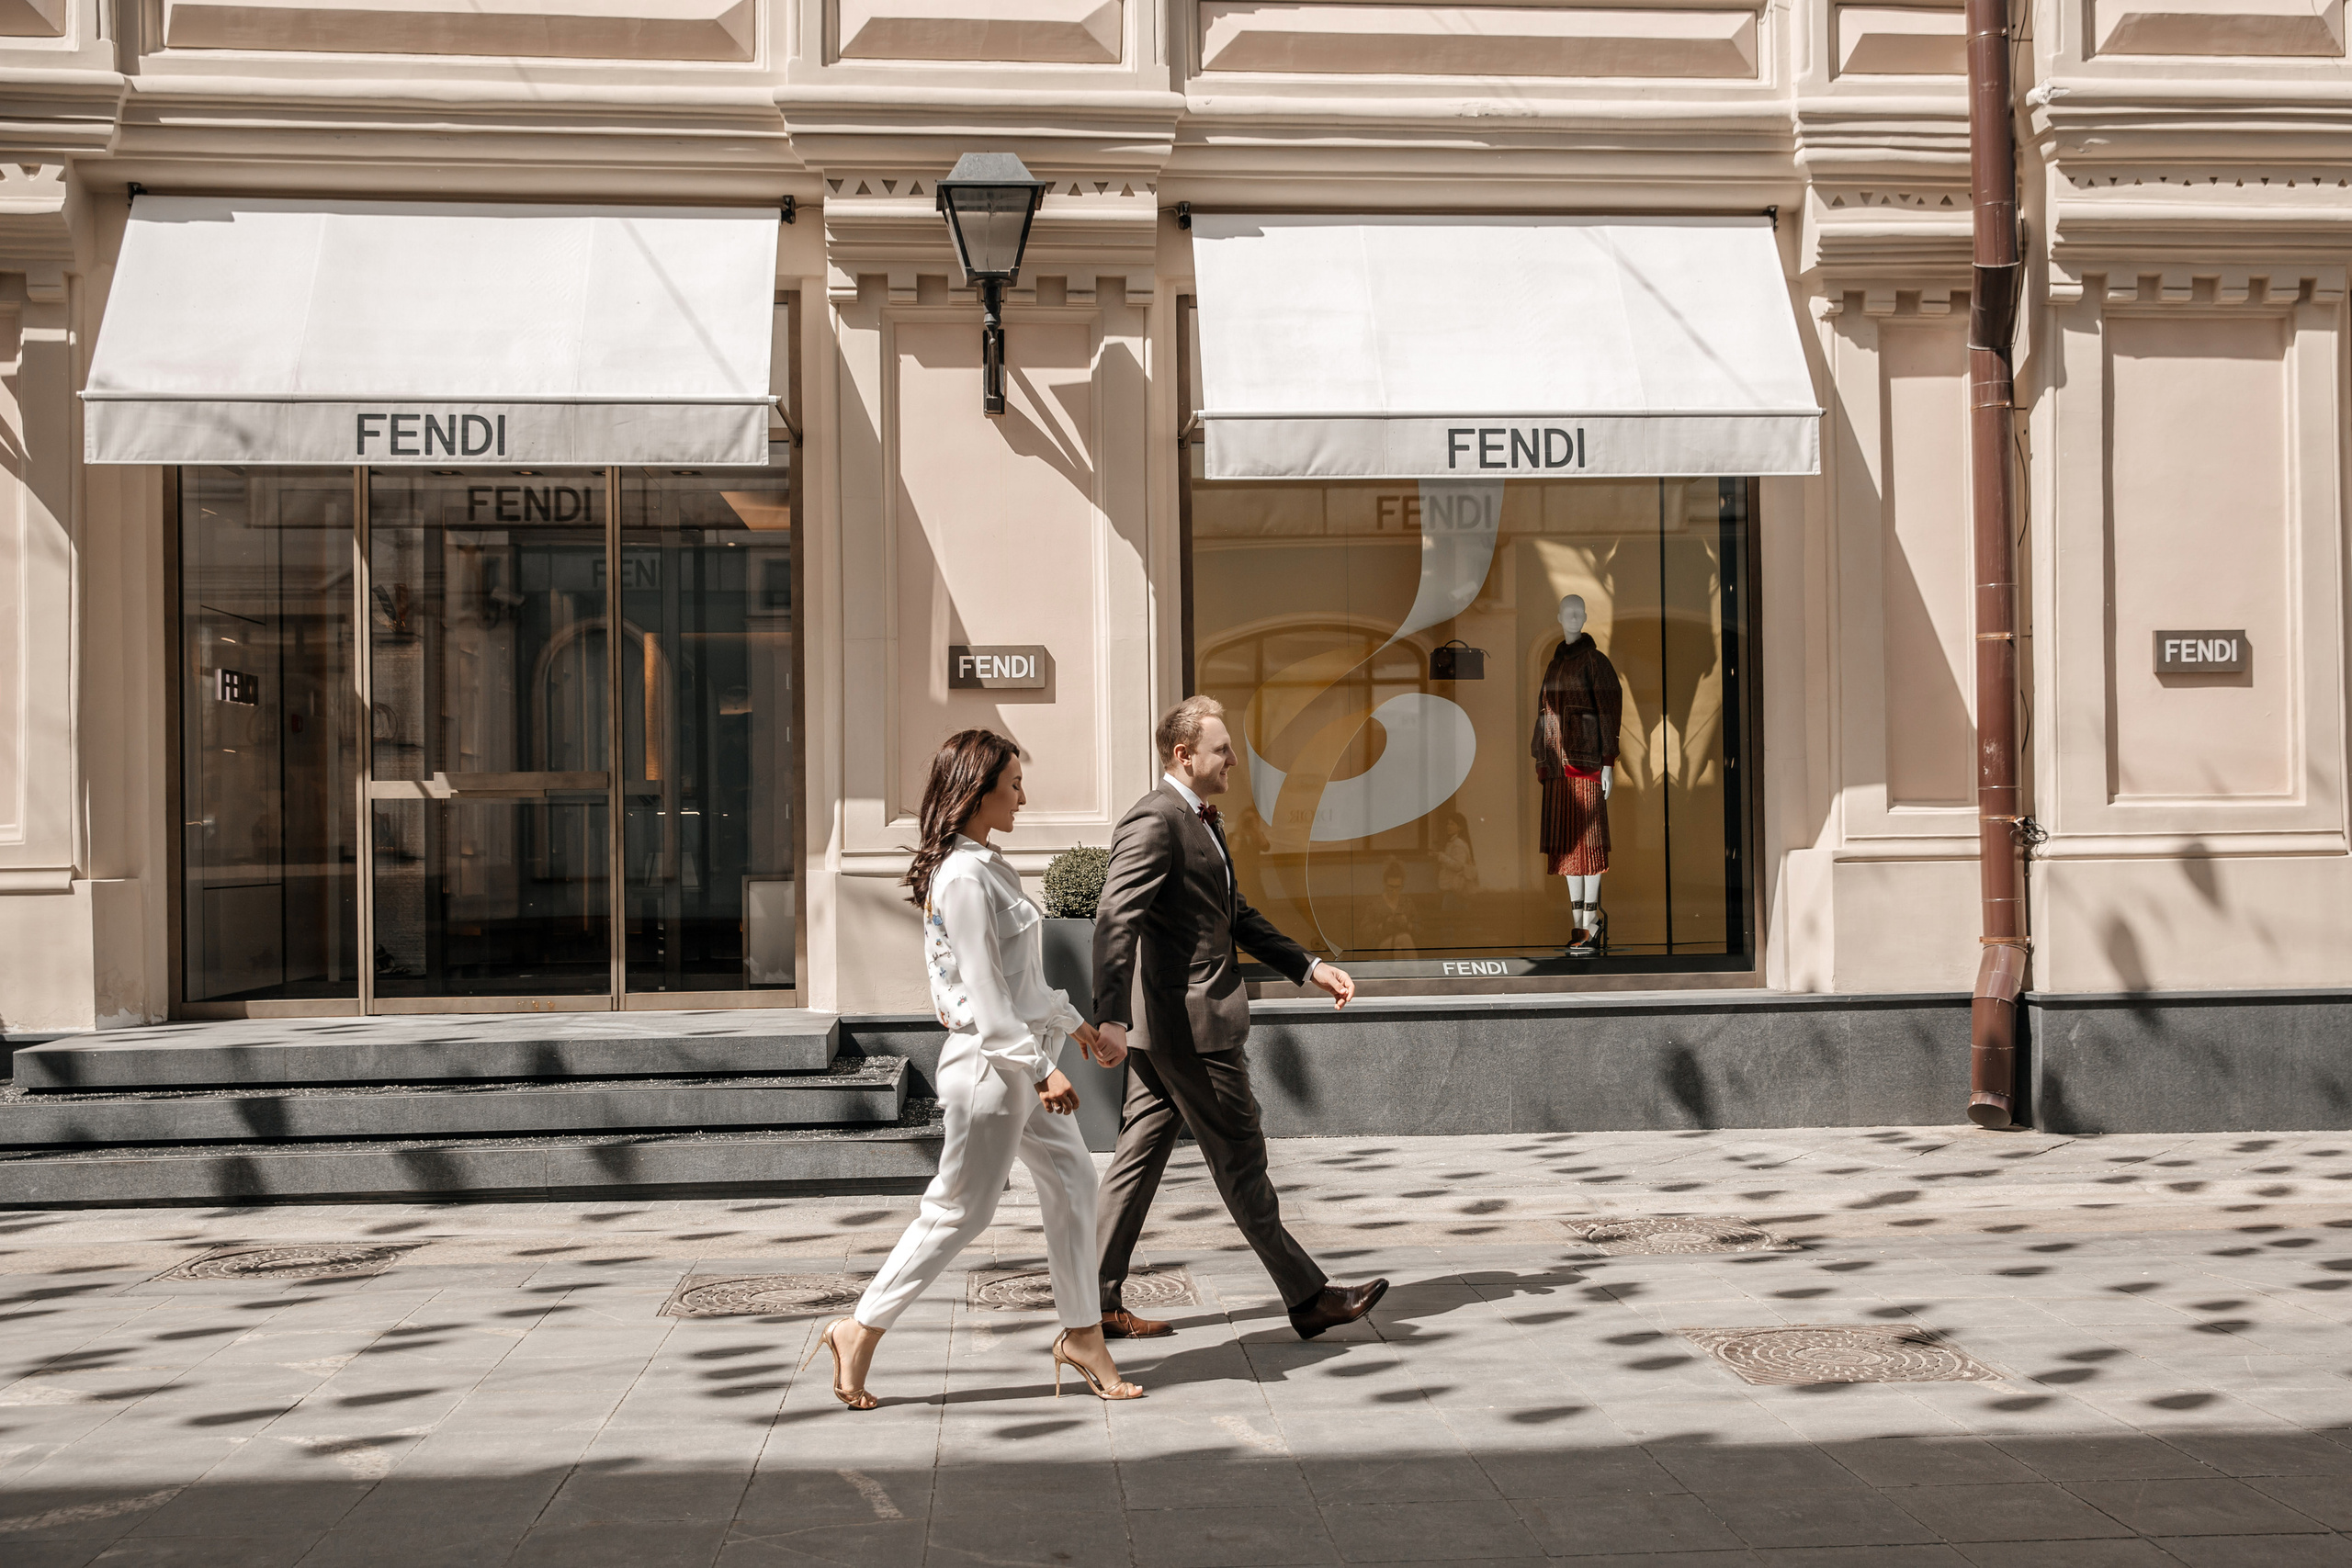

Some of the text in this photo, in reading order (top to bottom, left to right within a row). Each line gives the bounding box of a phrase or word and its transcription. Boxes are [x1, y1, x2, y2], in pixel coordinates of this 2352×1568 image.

[356, 413, 506, 457] FENDI
[1447, 427, 1586, 469] FENDI
[467, 485, 594, 523] FENDI
[1375, 494, 1493, 531] FENDI
[592, 558, 662, 589] FEN
[958, 655, 1035, 679] FENDI
[2165, 638, 2238, 663] FENDI
[1442, 961, 1509, 976] FENDI
